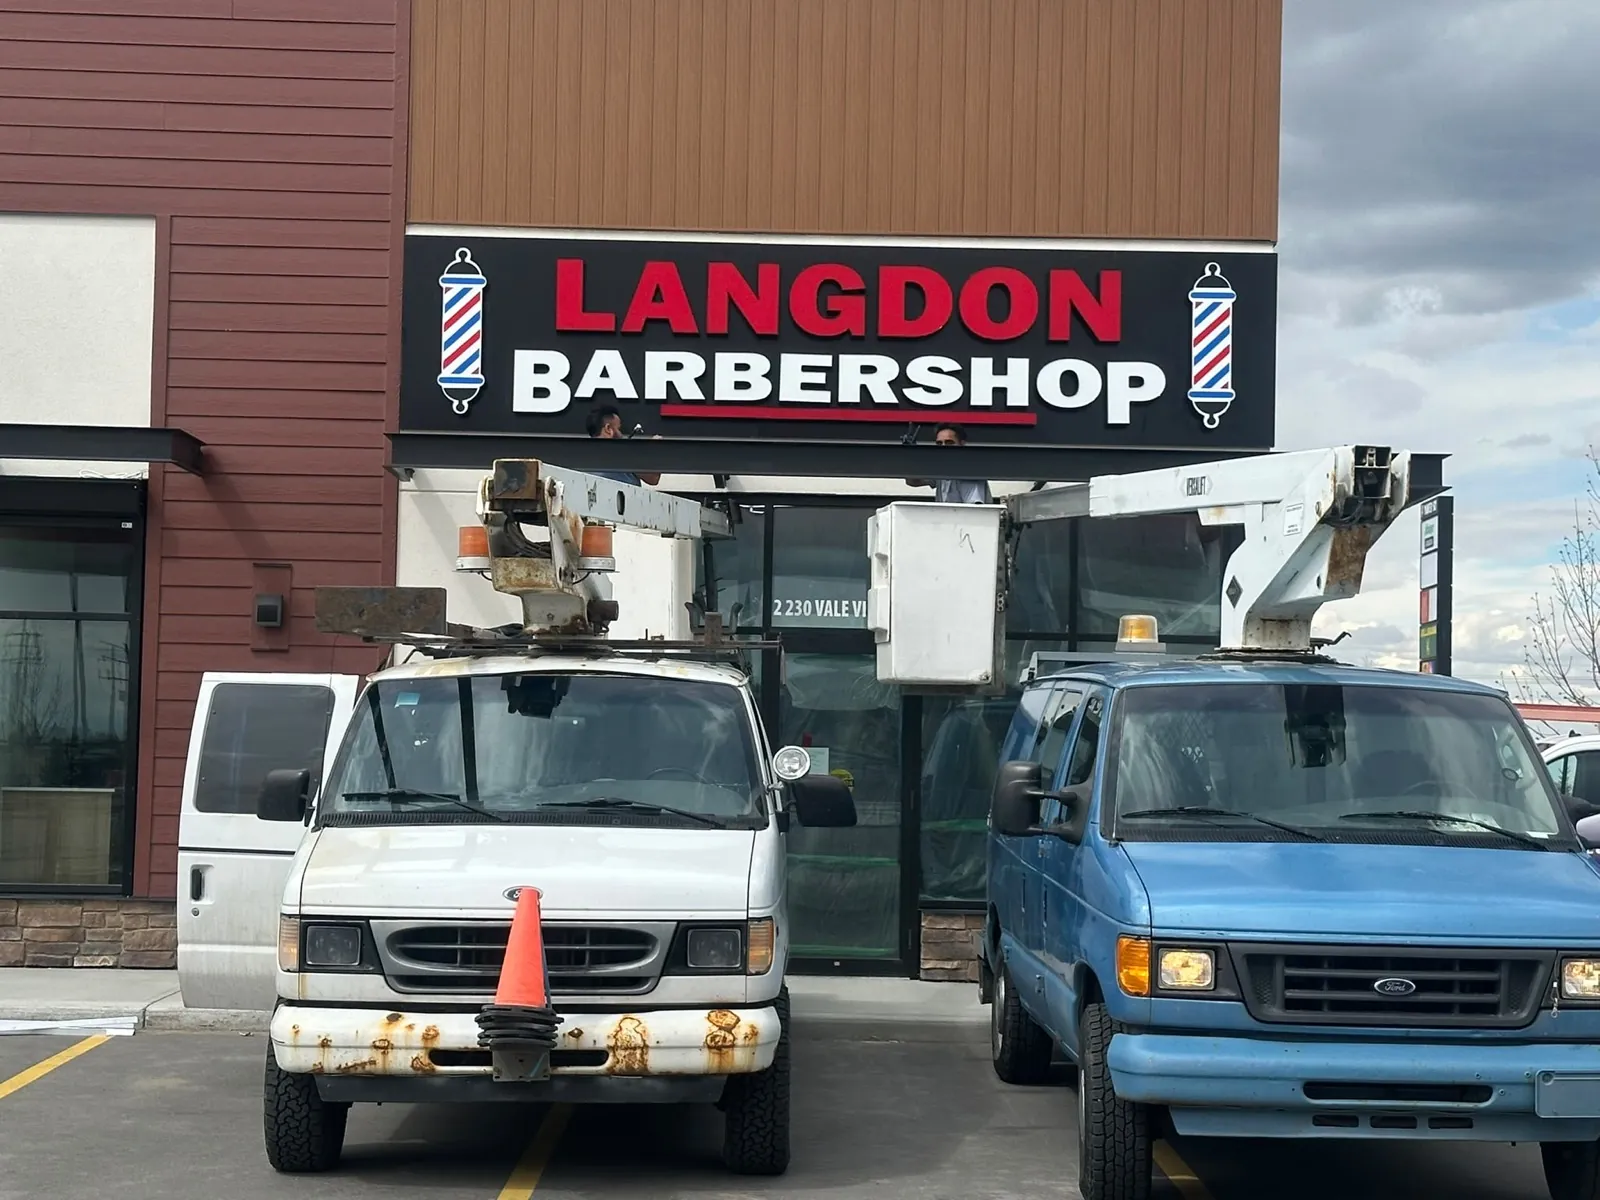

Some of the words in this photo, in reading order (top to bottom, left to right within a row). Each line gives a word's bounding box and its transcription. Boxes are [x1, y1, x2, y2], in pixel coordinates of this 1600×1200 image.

[555, 258, 1123, 342] LANGDON
[512, 349, 1167, 425] BARBERSHOP
[773, 599, 782, 616] 2
[785, 599, 812, 617] 230
[814, 600, 849, 617] VALE
